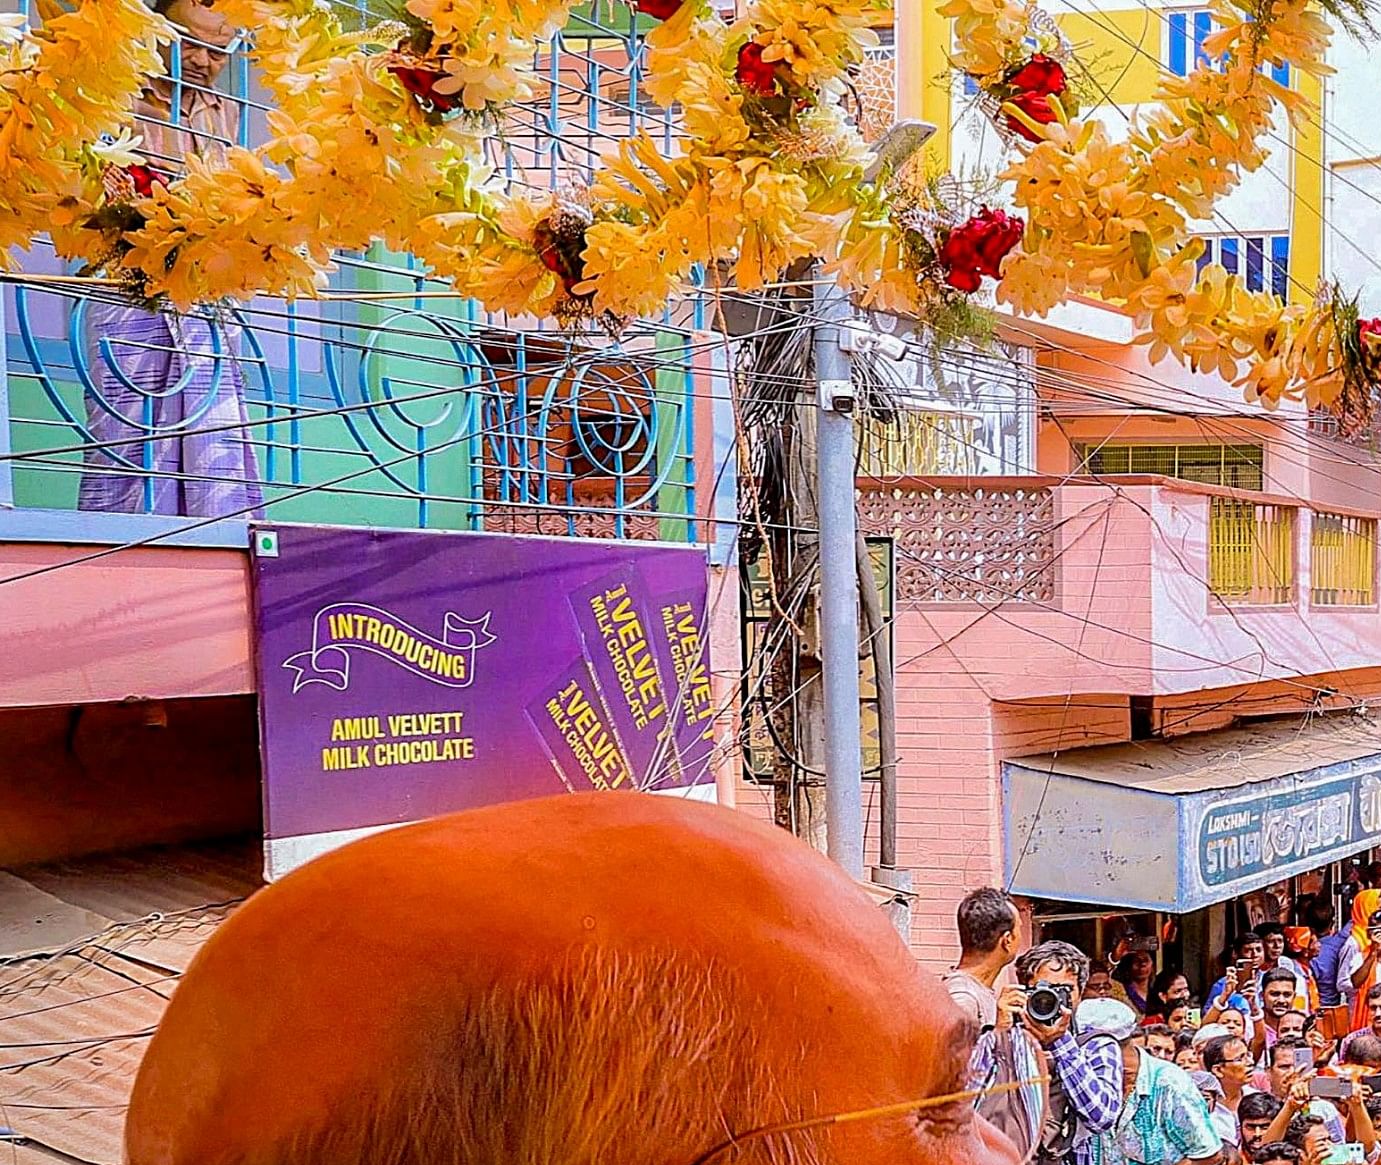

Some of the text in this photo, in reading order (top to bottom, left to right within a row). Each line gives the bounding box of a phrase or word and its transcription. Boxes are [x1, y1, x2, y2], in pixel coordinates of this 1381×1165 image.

[661, 606, 678, 643] MILK
[328, 613, 465, 679] INTRODUCING
[590, 595, 649, 731] MILK CHOCOLATE
[331, 712, 463, 741] AMUL VELVETT
[545, 698, 573, 735] MILK
[322, 738, 474, 771] MILK CHOCOLATE
